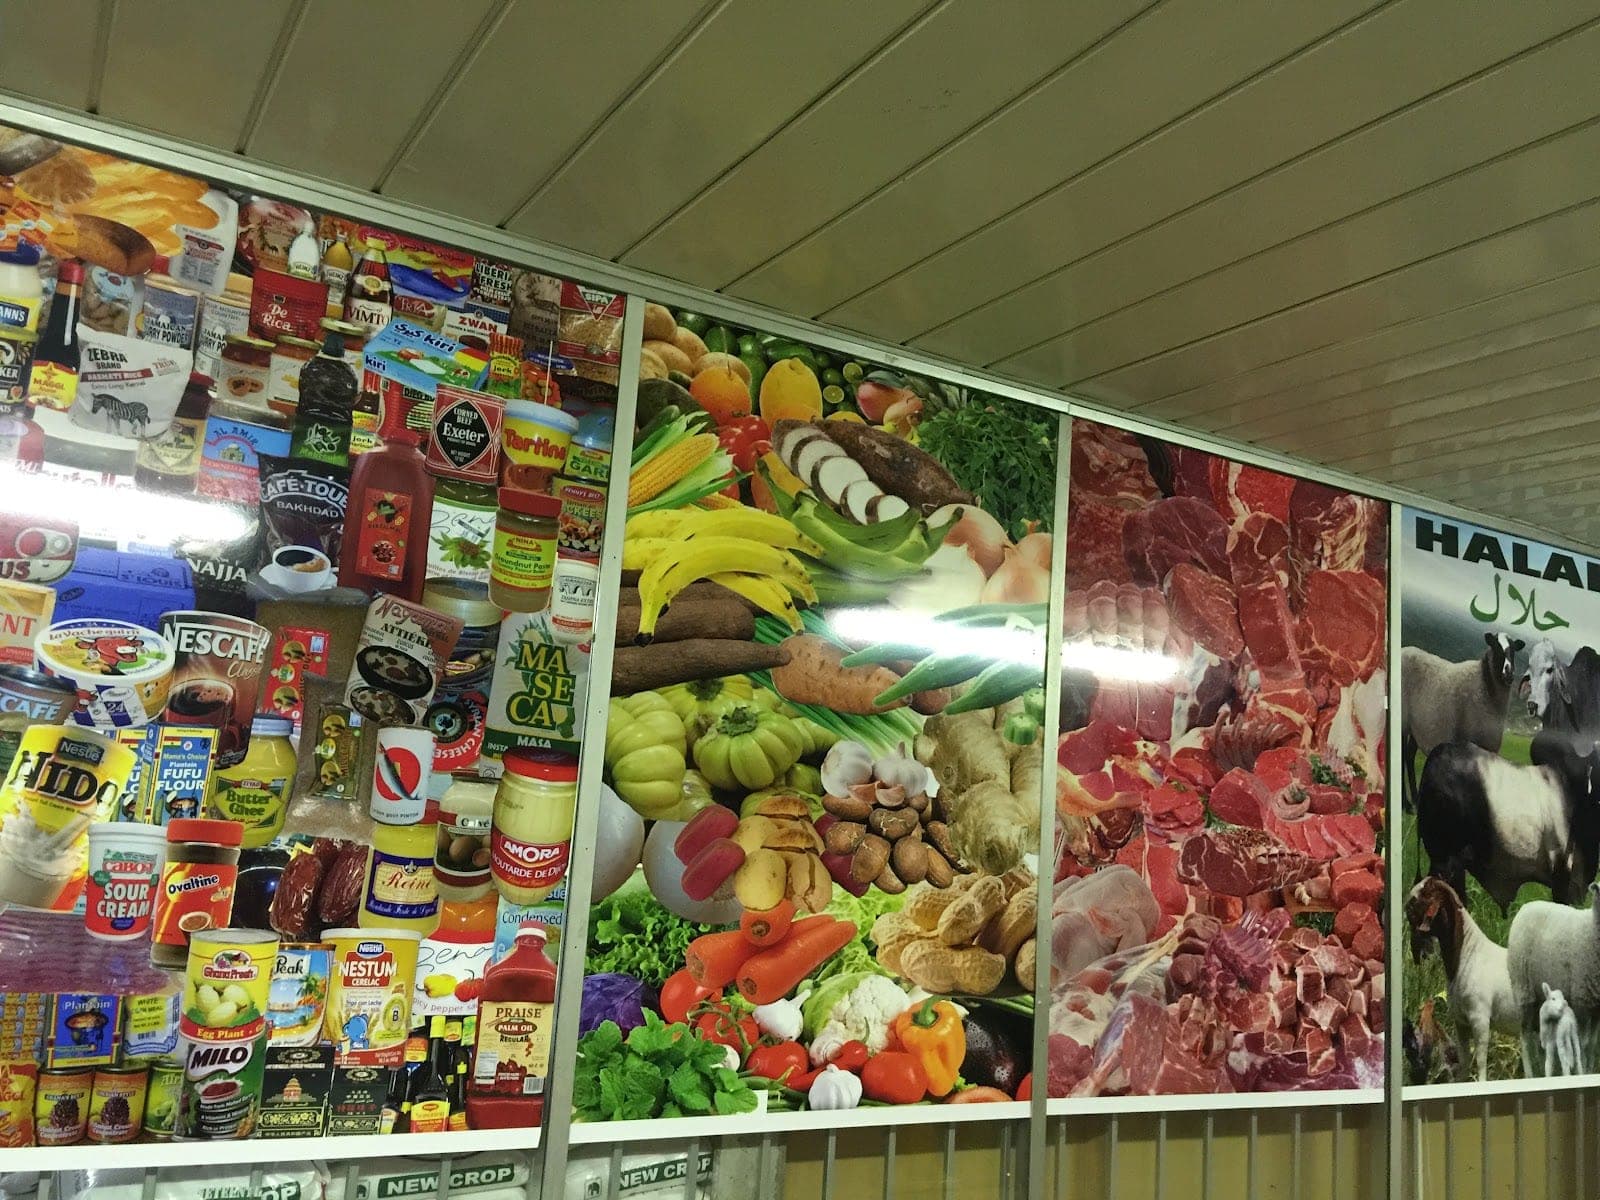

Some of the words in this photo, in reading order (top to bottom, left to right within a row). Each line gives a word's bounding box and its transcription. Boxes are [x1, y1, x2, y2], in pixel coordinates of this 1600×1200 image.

[269, 303, 288, 319] De
[261, 313, 297, 332] Rica
[458, 315, 499, 333] ZWAN
[424, 334, 458, 353] kiri
[87, 347, 128, 363] ZEBRA
[365, 354, 387, 371] kiri
[453, 407, 479, 420] CORNED
[442, 421, 486, 443] Exeter
[276, 501, 339, 519] BAKHDAD
[1469, 572, 1570, 632] حلال
[63, 629, 101, 638] Vache
[517, 735, 552, 749] MASA
[169, 761, 198, 769] Plantain
[163, 768, 202, 779] FUFU
[157, 780, 205, 791] FLOUR
[226, 790, 273, 805] Butter
[228, 802, 265, 816] Ghee
[503, 840, 560, 863] AMORA
[534, 869, 549, 879] DE
[104, 882, 149, 901] SOUR
[168, 874, 220, 895] Ovaltine
[97, 900, 150, 919] CREAM
[502, 910, 563, 925] Condensed
[274, 955, 304, 975] Peak
[338, 960, 398, 978] NESTUM
[351, 977, 380, 987] CERELAC
[64, 1000, 111, 1011] Planin
[430, 1003, 463, 1014] pepper
[495, 1007, 542, 1019] PRAISE
[197, 1028, 215, 1040] Egg
[218, 1029, 245, 1039] Plant
[498, 1024, 519, 1032] PALM
[190, 1046, 249, 1070] MILO
[386, 1176, 440, 1196] NEW
[450, 1167, 513, 1188] CROP
[620, 1166, 662, 1188] NEW
